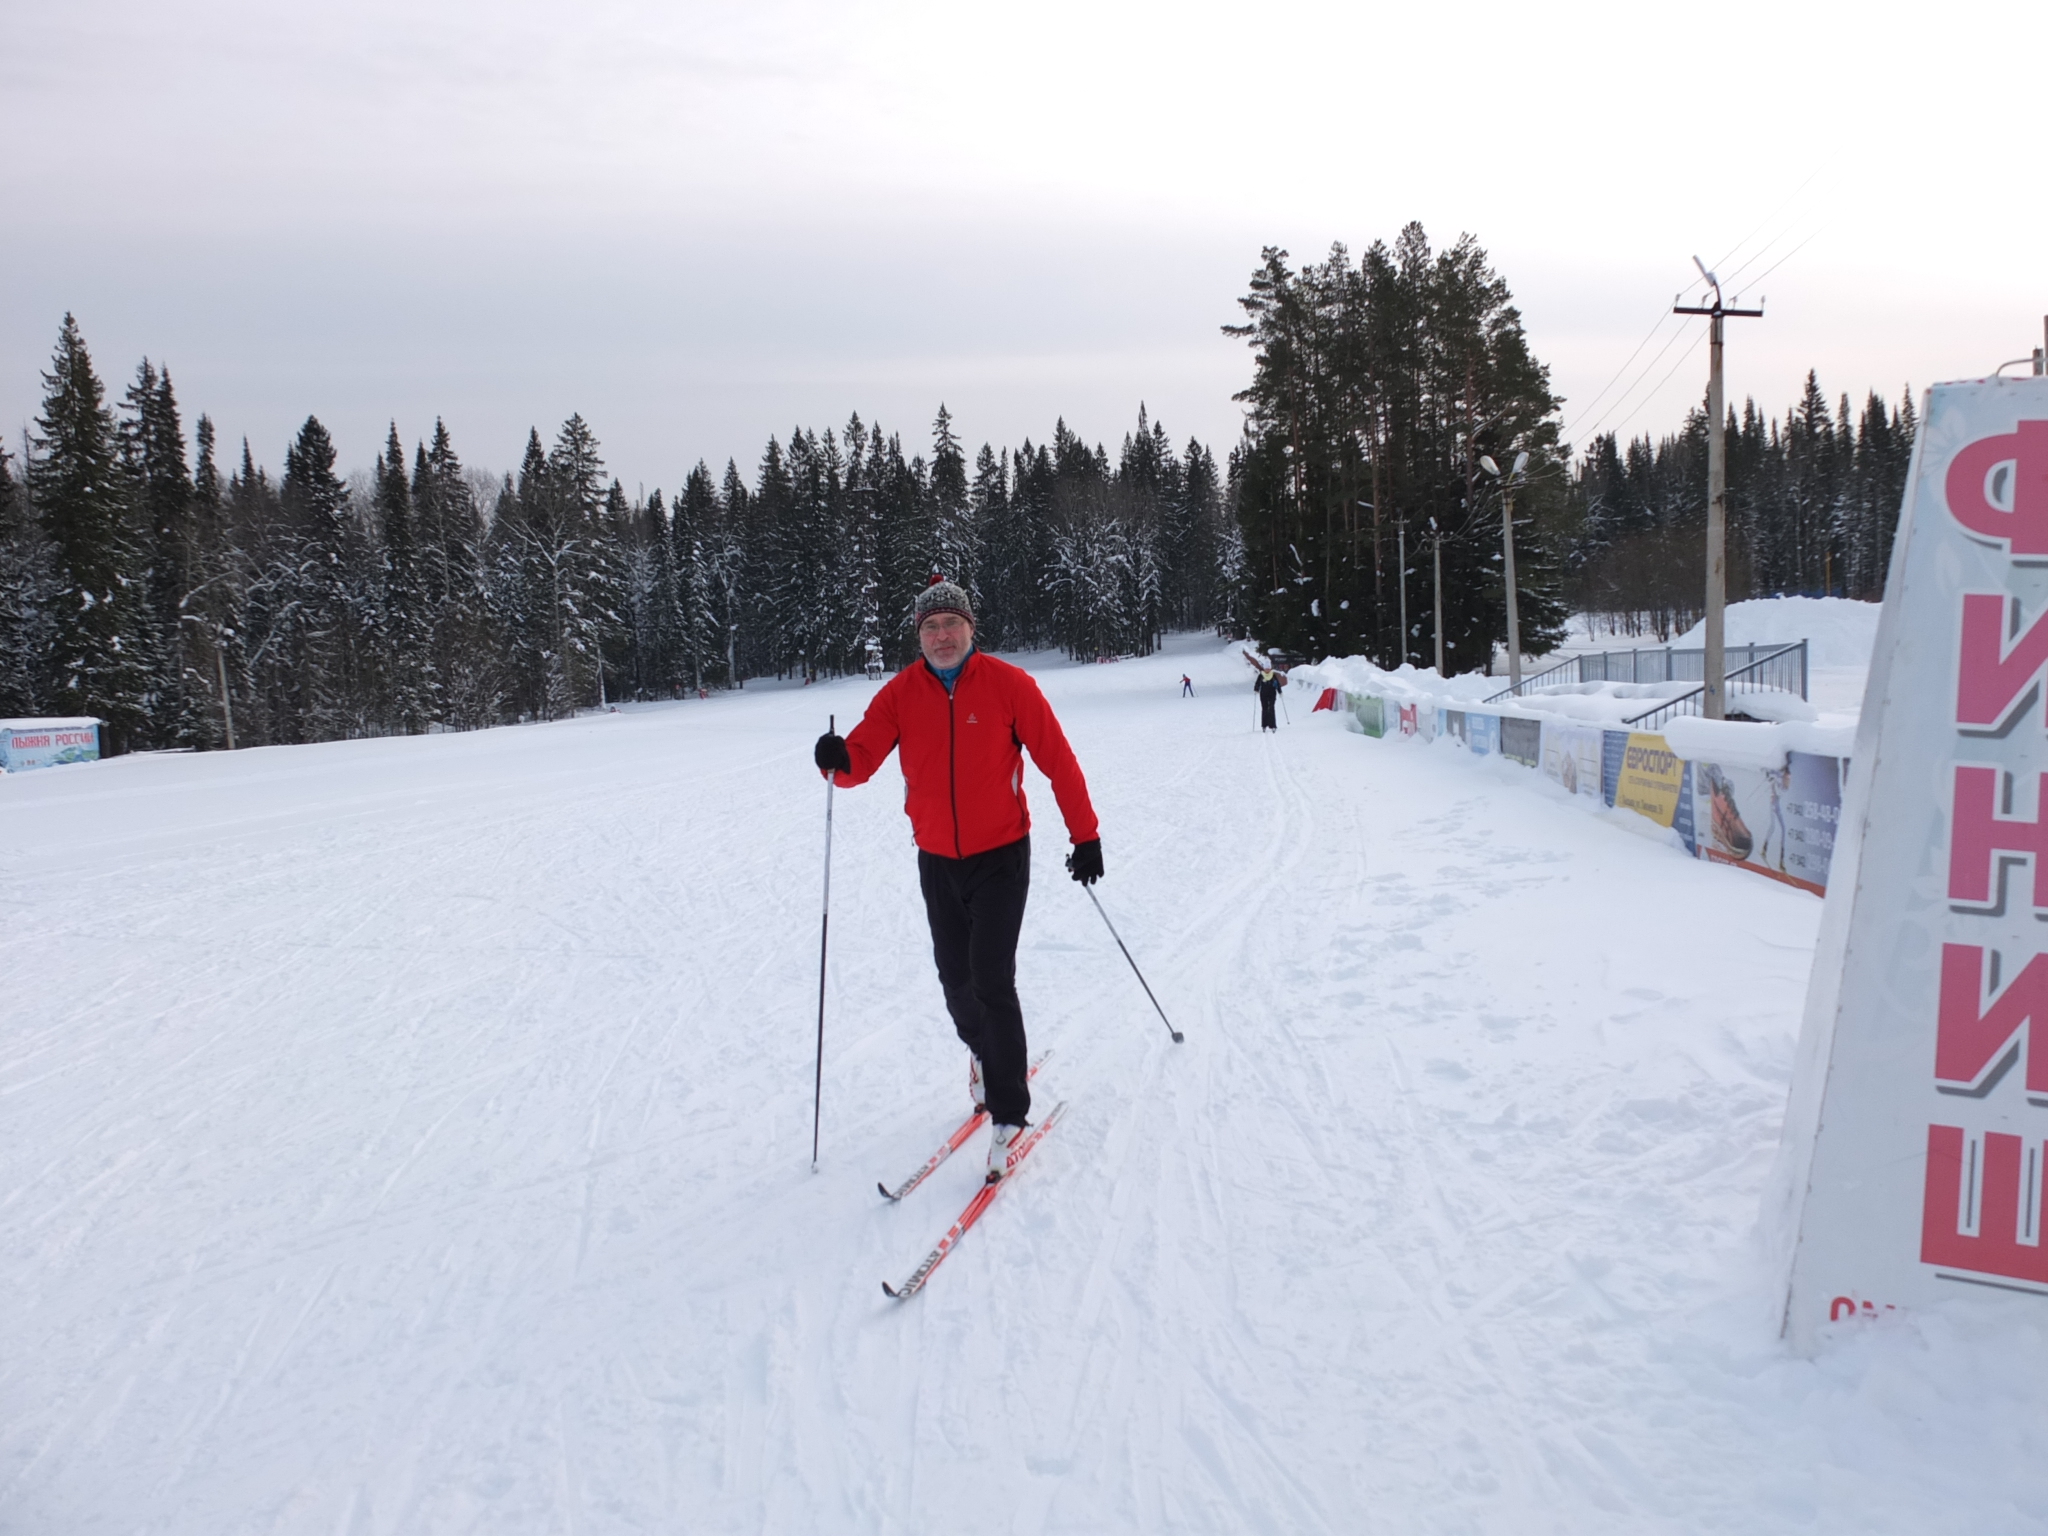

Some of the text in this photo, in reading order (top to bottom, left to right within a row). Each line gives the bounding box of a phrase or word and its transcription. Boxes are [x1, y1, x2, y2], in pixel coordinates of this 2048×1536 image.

[11, 731, 95, 750] ЛЫЖНЯ РОССИИ
[1917, 418, 2048, 1287] ФИНИШ
[899, 1249, 941, 1296] ATOMIC
